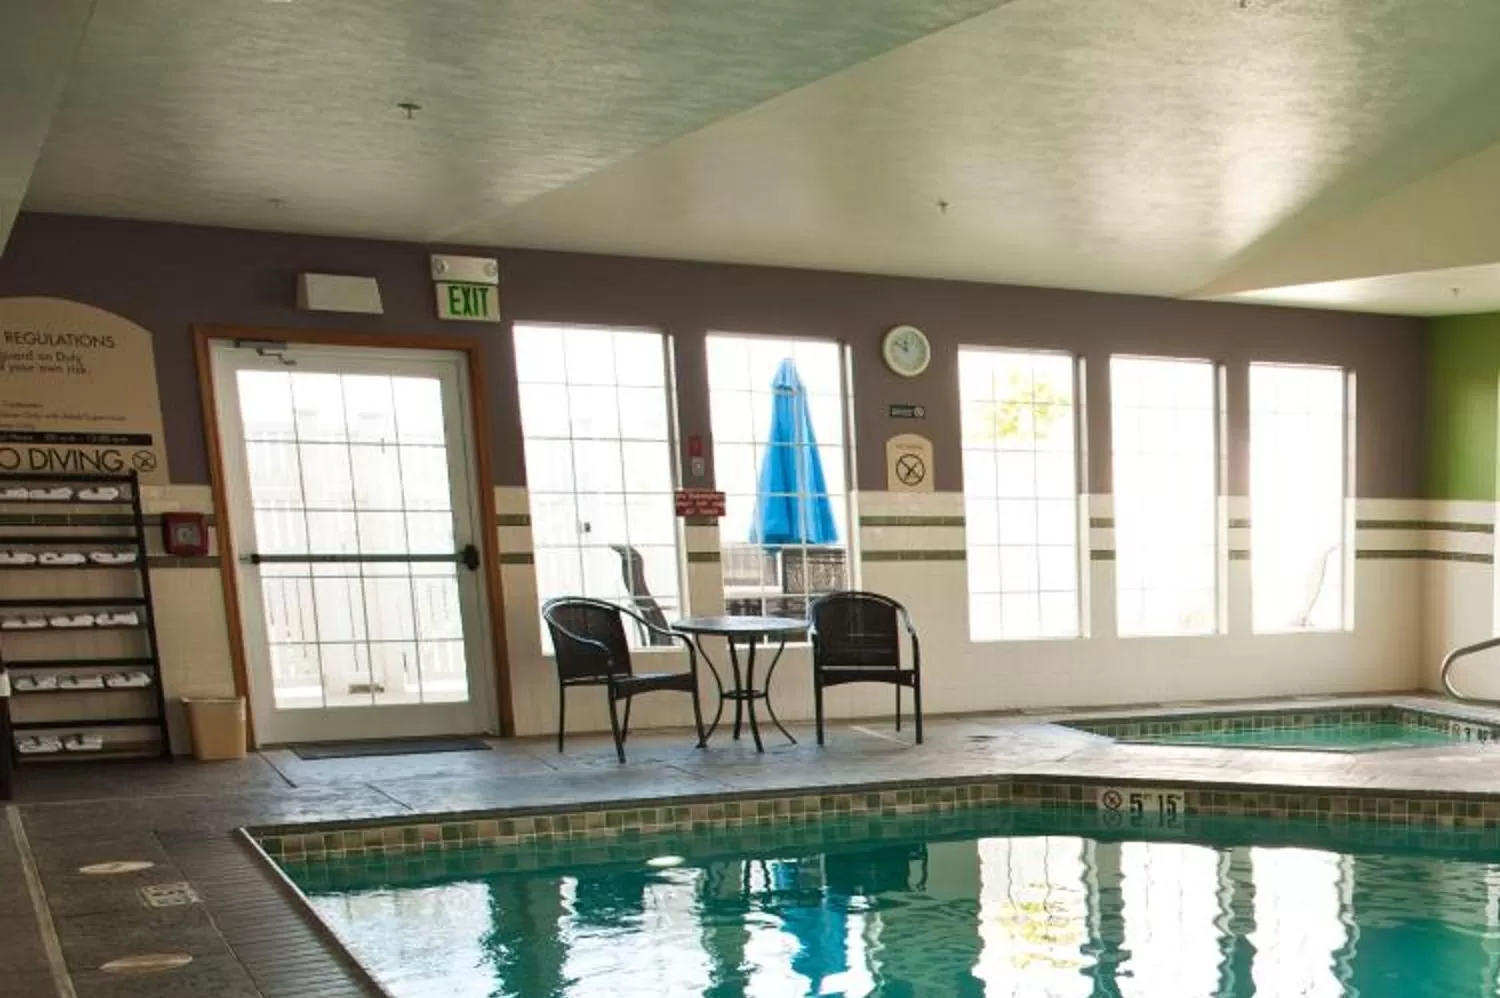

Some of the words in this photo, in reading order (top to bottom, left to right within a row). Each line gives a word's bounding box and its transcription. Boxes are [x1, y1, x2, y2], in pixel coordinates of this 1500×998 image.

[448, 285, 489, 317] EXIT
[4, 331, 115, 349] REGULATIONS
[28, 447, 125, 473] DIVING
